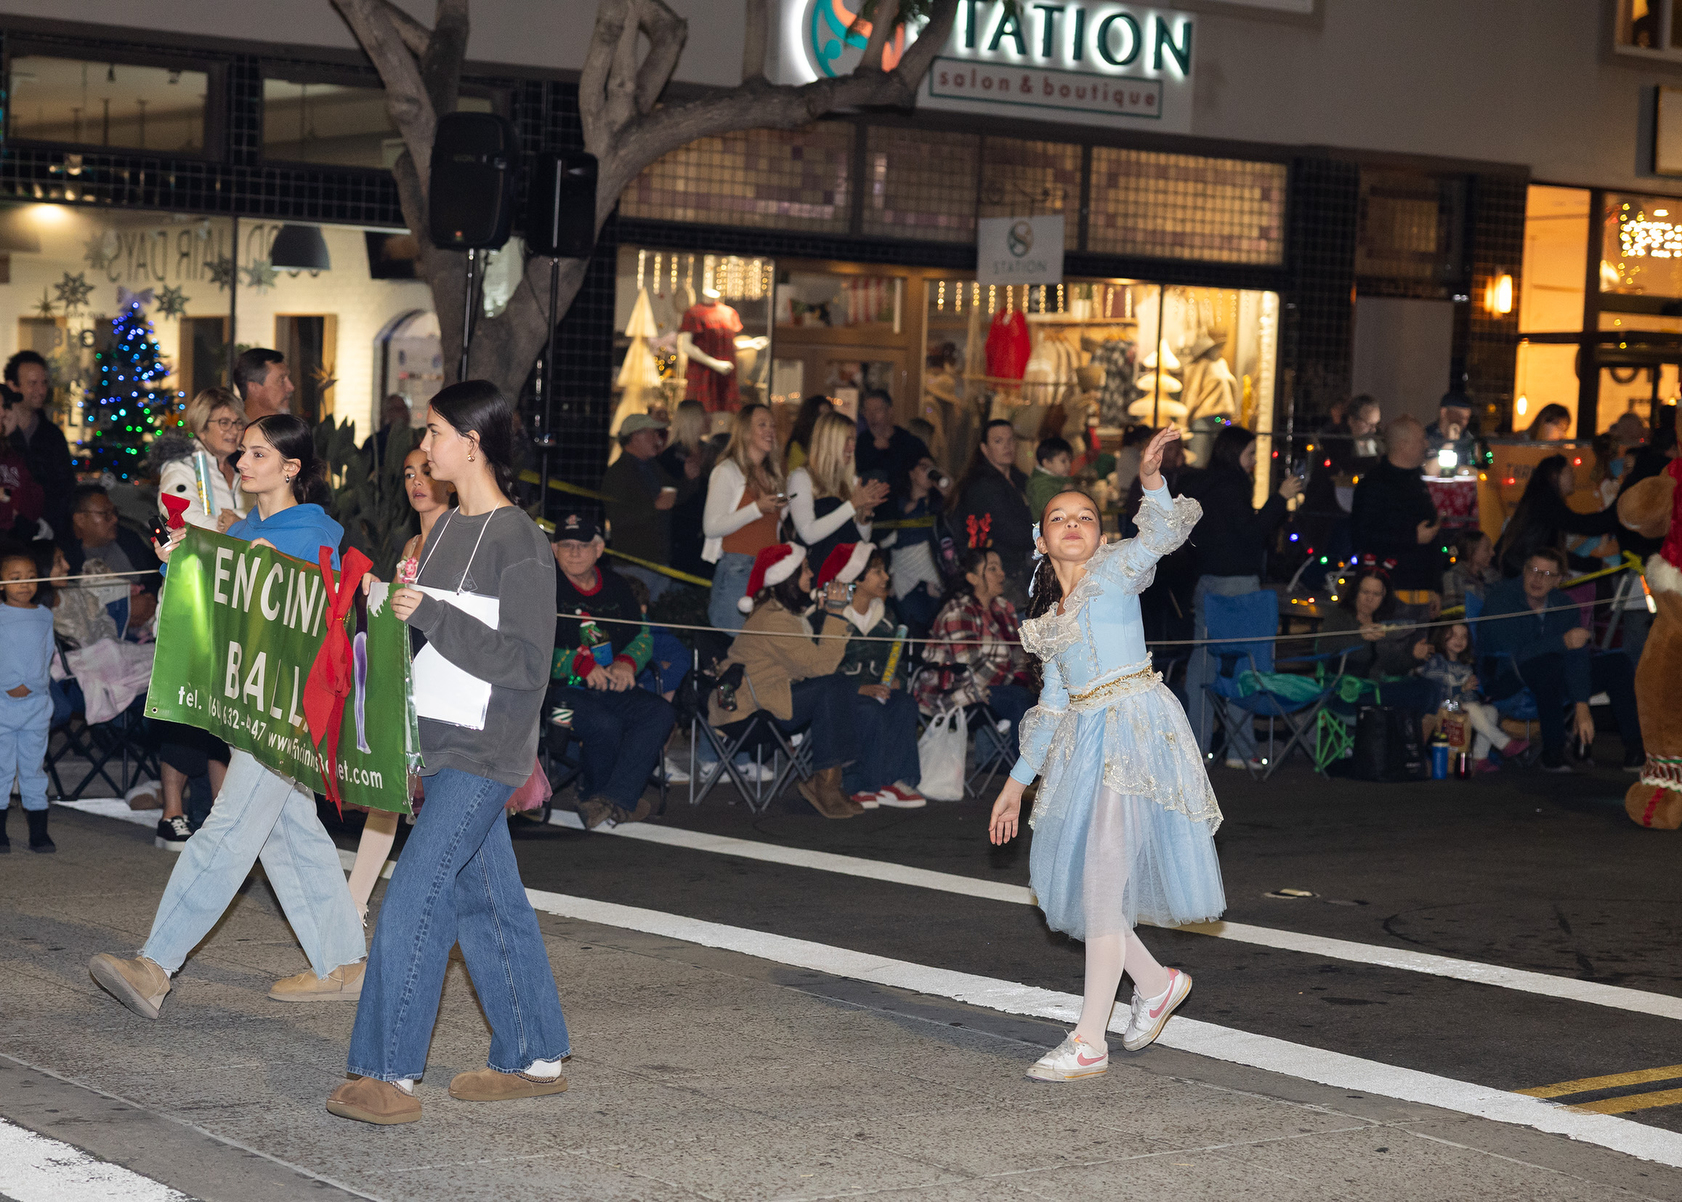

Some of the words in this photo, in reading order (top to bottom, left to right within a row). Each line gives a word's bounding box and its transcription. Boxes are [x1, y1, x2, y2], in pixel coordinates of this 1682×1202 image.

[956, 0, 1193, 76] TATION
[939, 67, 1011, 92] salon
[1020, 74, 1033, 94] &
[1042, 75, 1156, 108] boutique
[213, 546, 340, 637] ENCINI
[178, 686, 202, 710] tel.
[224, 640, 309, 733] BALL
